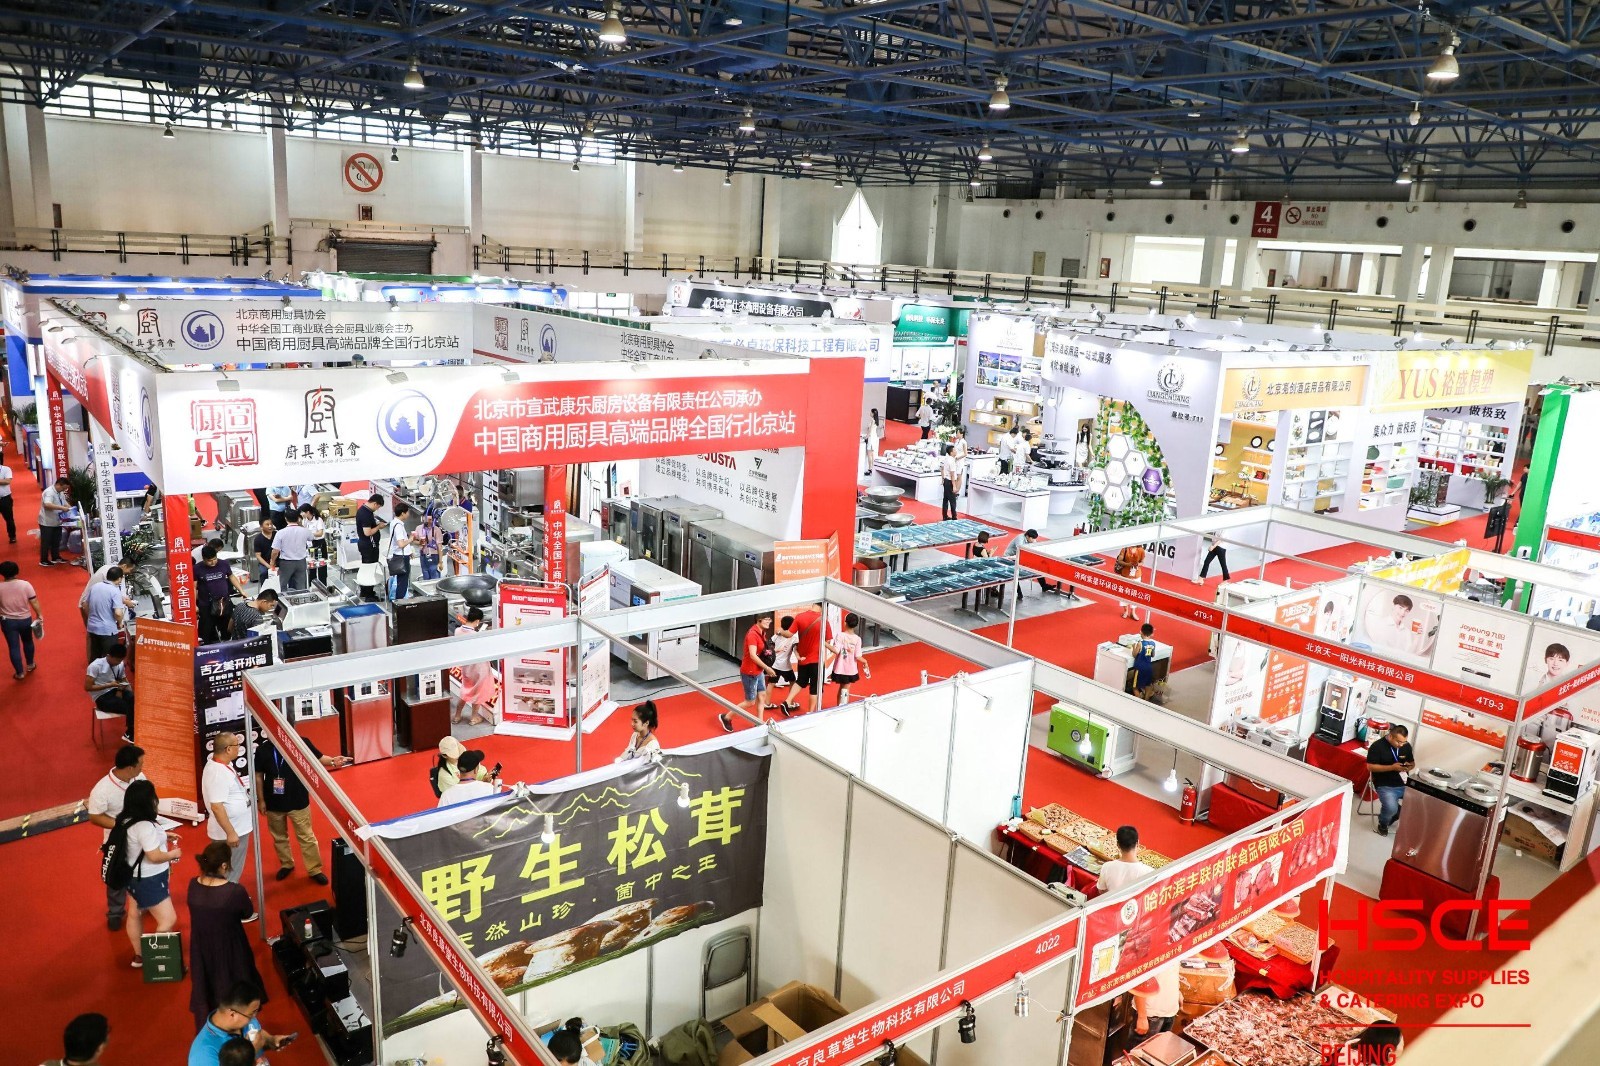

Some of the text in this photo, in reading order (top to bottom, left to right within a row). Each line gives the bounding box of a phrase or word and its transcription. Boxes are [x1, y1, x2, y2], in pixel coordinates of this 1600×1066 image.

[1261, 205, 1273, 223] 4
[236, 308, 327, 320] 北京商用厨具协会
[237, 323, 414, 335] 中华全国工商业联合会厨具业商会主办
[236, 335, 459, 352] 中国商用厨具高端品牌全国行北京站
[620, 332, 675, 354] 北京商用厨具协会
[1398, 368, 1495, 400] YUS 裕盛模塑
[473, 388, 763, 421] 北京市宣武康乐厨房设备有限责任公司承办
[1468, 404, 1507, 421] 做极致
[473, 409, 797, 456] 中国商用厨具高端品牌全国行北京站
[704, 452, 737, 470] JUSTA
[1193, 609, 1213, 622] 4T9-1
[1305, 643, 1415, 683] 北京天一阳光科技有限公司
[1476, 695, 1504, 711] 4T9-3
[421, 786, 746, 924] 野生松茸
[1142, 818, 1305, 913] 哈尔滨丰联肉联食品有限公司
[1035, 934, 1061, 956] 4022
[786, 979, 966, 1066] 京良草堂生物科技有限公司
